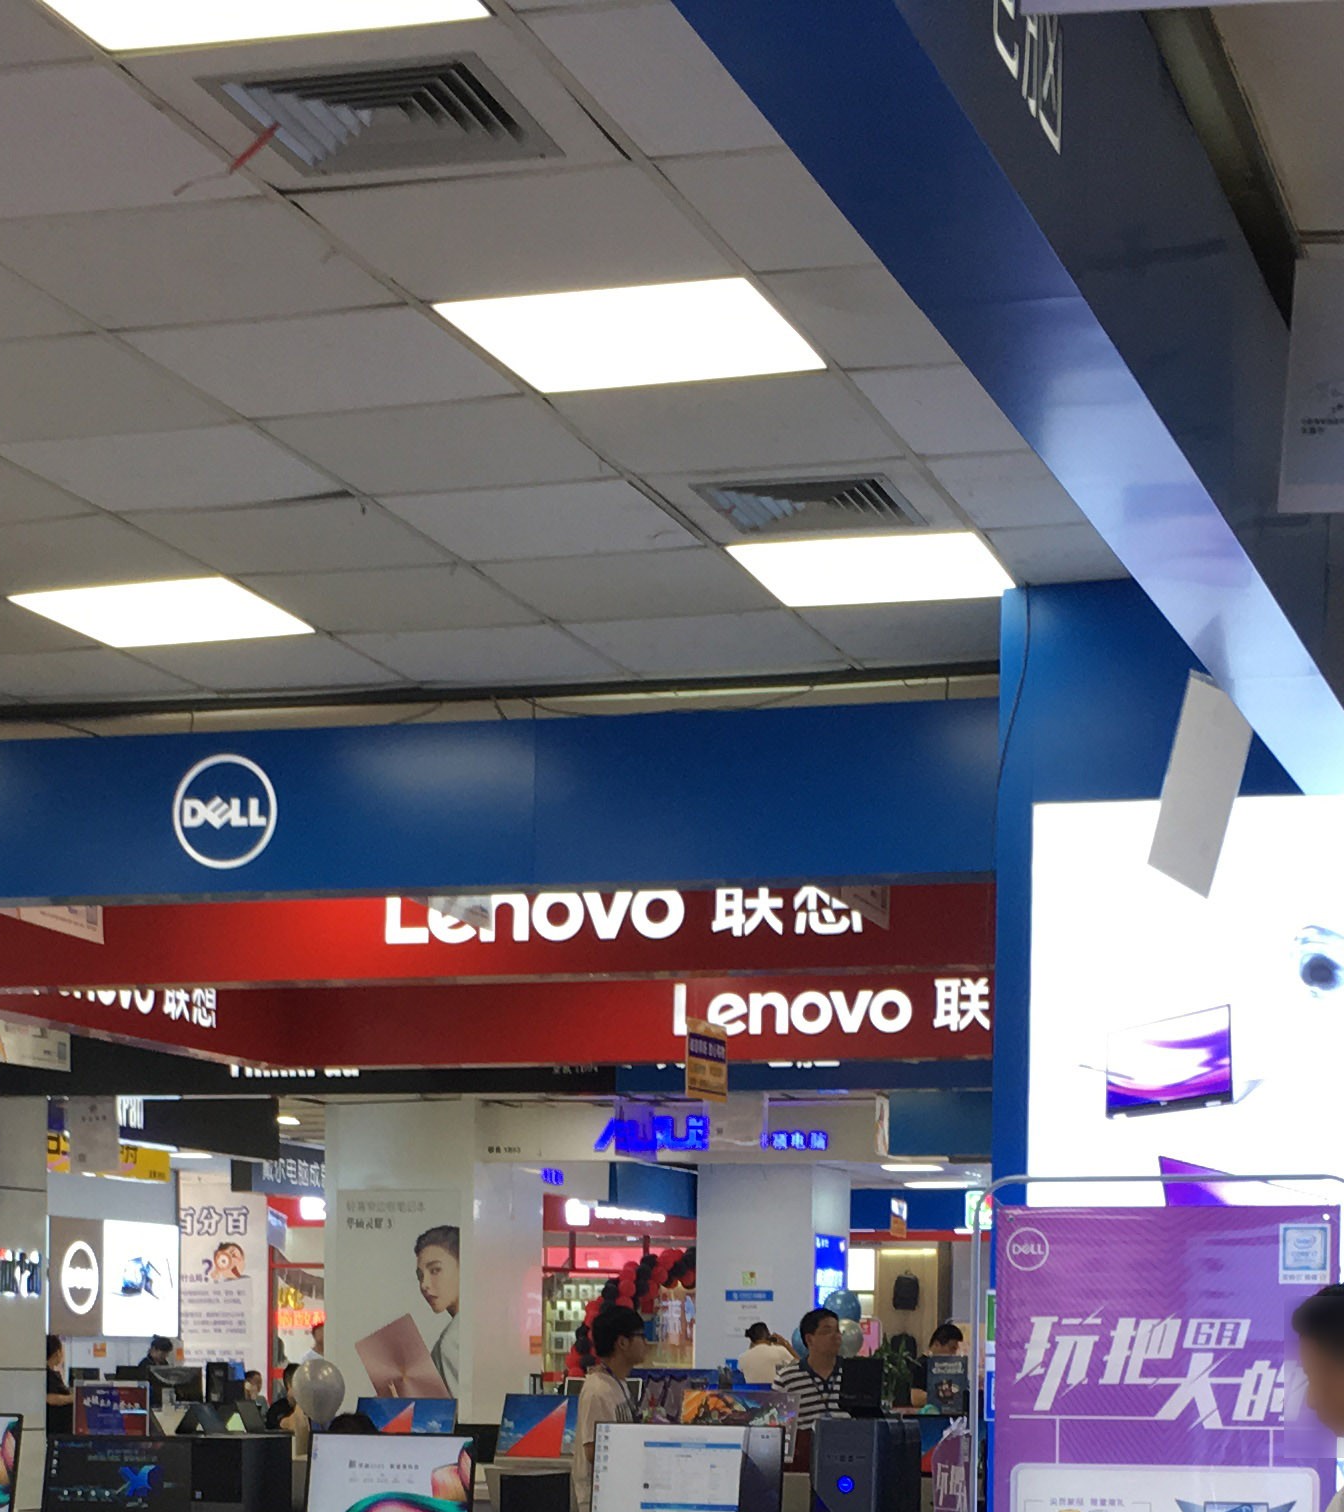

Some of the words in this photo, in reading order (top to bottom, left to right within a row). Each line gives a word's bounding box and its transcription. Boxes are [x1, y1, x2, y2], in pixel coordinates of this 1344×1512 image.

[182, 796, 268, 830] DELL
[384, 888, 686, 945] Lenovo
[673, 983, 913, 1036] Lenovo
[1011, 1242, 1045, 1257] DELL
